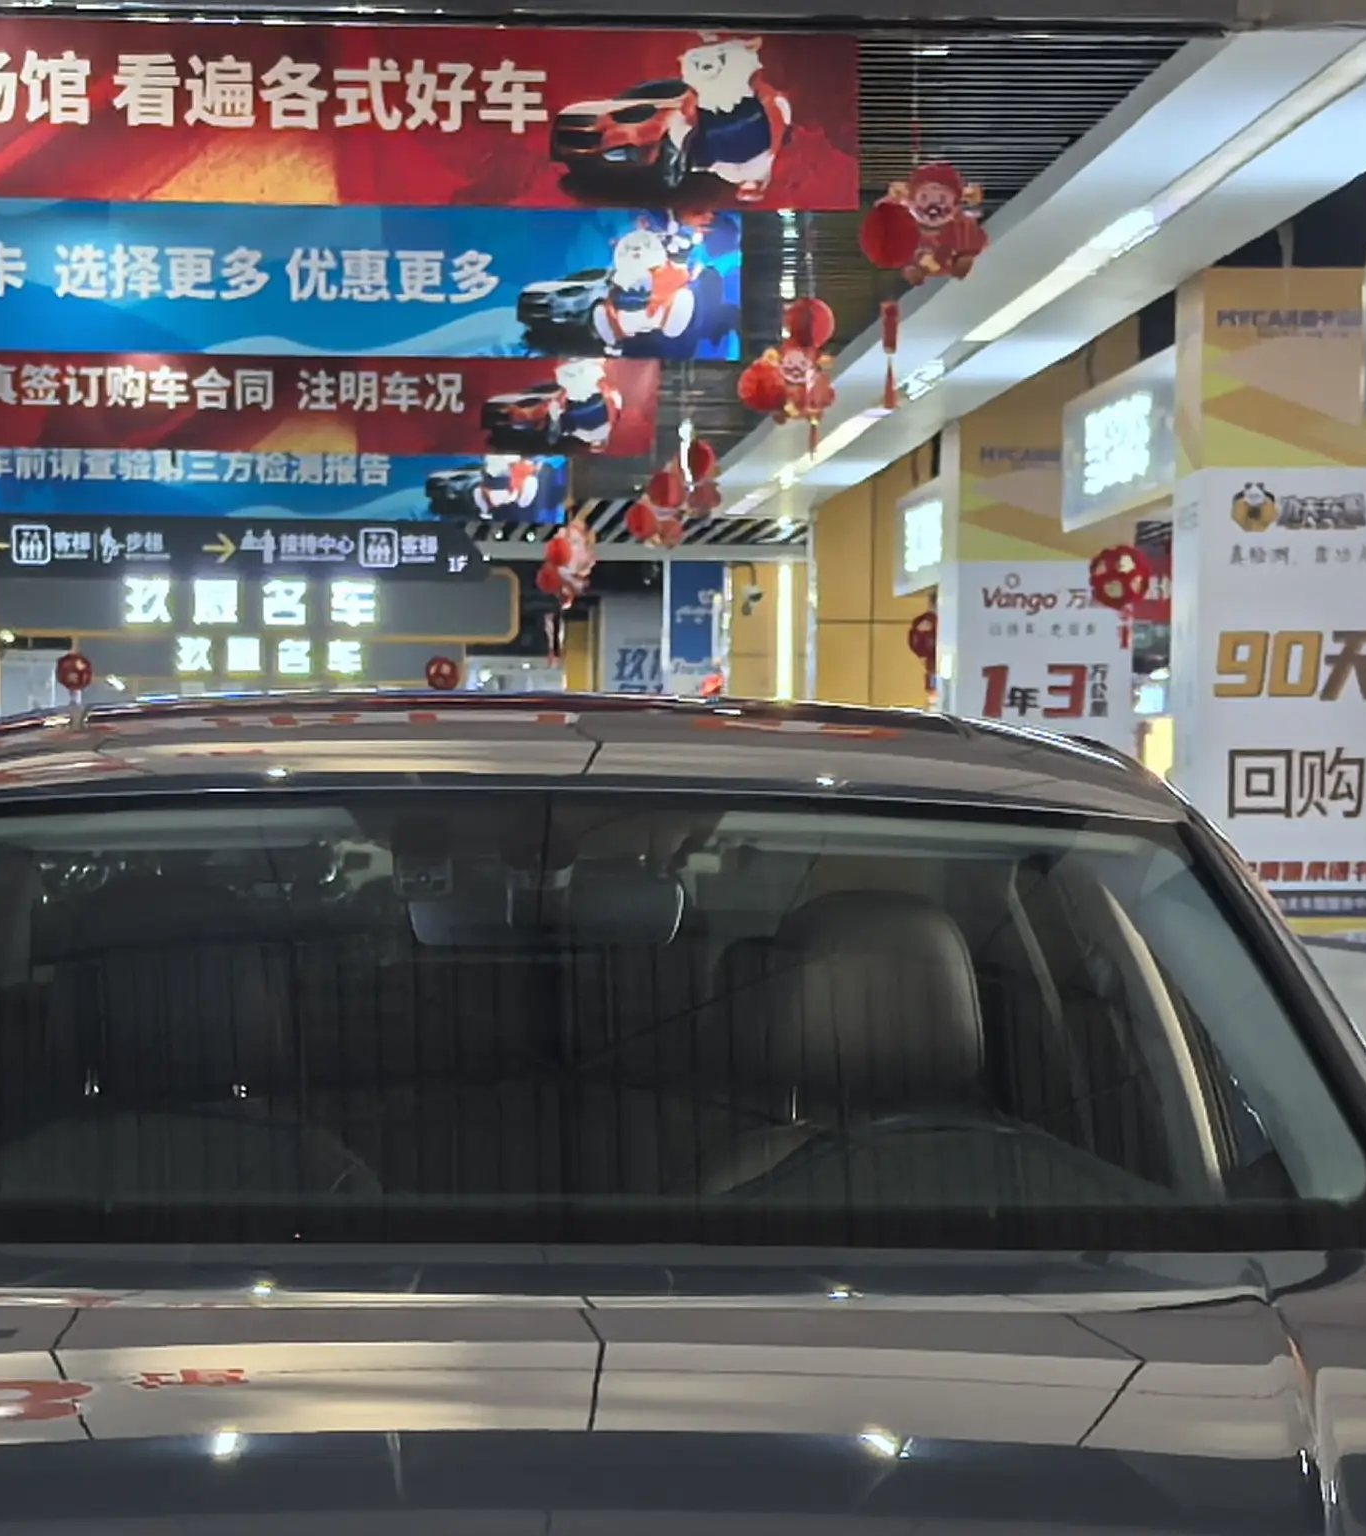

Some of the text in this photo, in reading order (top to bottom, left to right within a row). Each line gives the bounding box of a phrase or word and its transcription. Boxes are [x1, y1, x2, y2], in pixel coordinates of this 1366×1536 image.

[113, 53, 549, 134] 看遍各式好车
[55, 244, 270, 300] 选择更多
[285, 247, 501, 304] 优惠更多
[297, 369, 465, 414] 注明车况
[981, 587, 1058, 616] Vango
[1228, 747, 1365, 818] 回购
